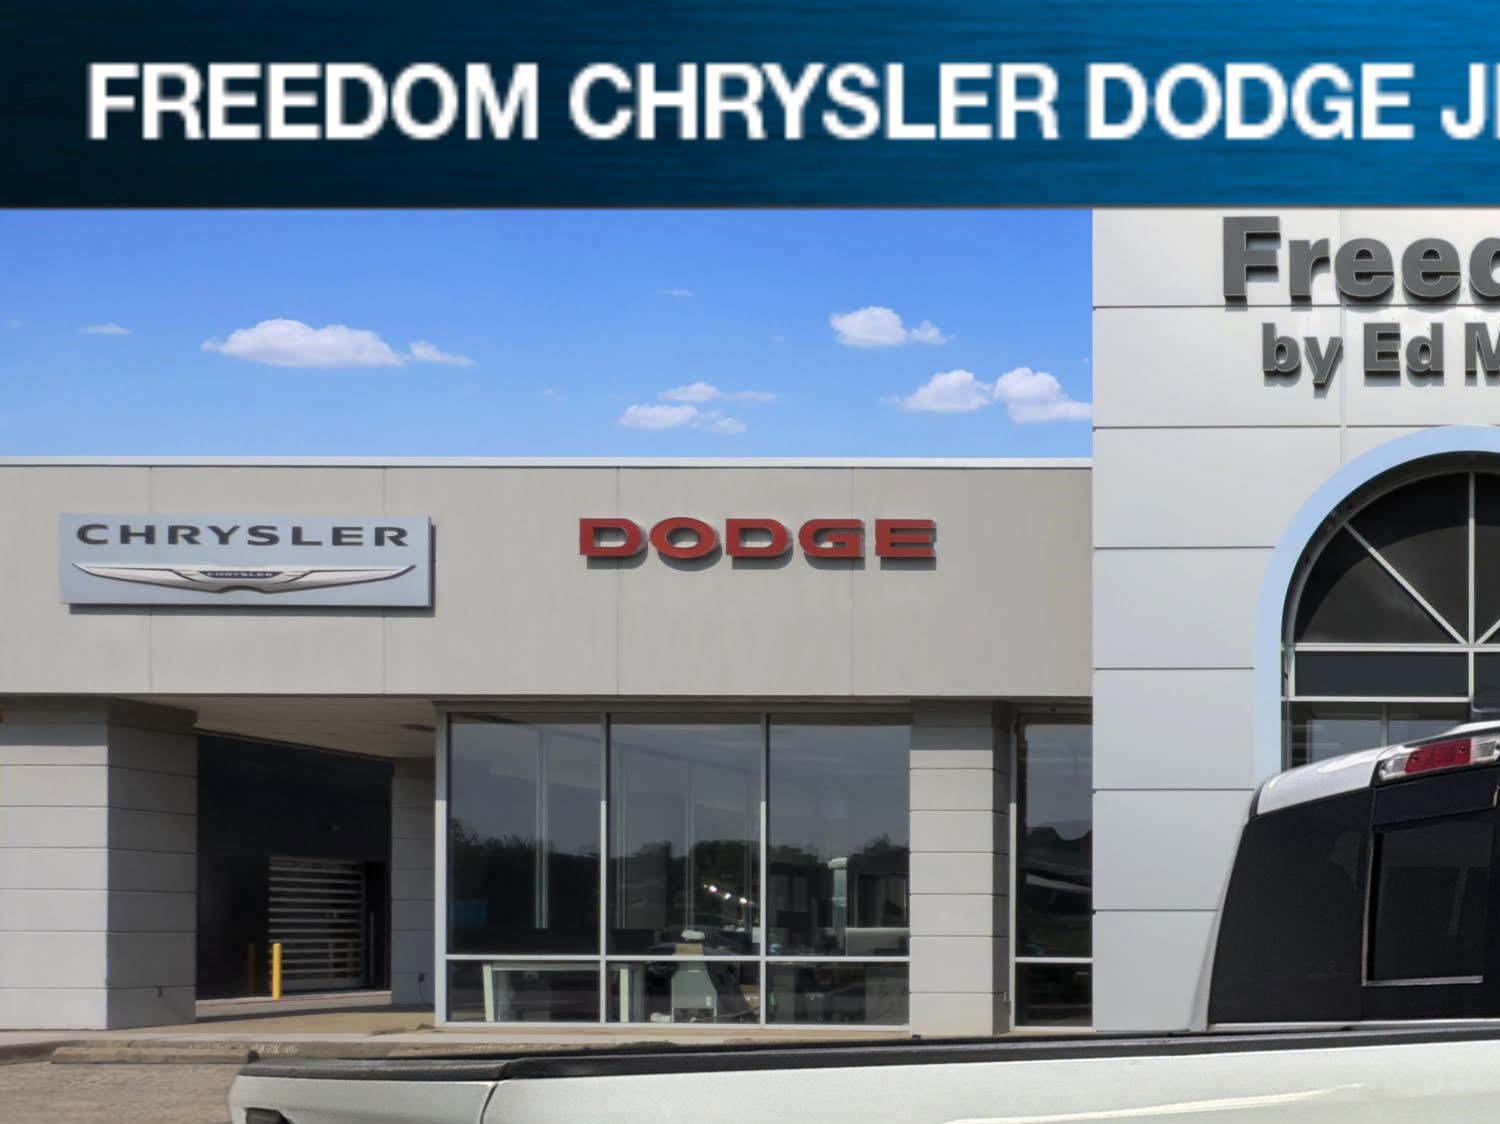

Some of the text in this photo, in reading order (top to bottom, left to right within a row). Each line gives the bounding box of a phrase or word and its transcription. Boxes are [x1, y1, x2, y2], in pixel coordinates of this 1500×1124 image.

[1262, 323, 1343, 386] by
[1363, 323, 1444, 377] Ed
[76, 523, 408, 547] CHRYSLER
[579, 516, 936, 559] DODGE
